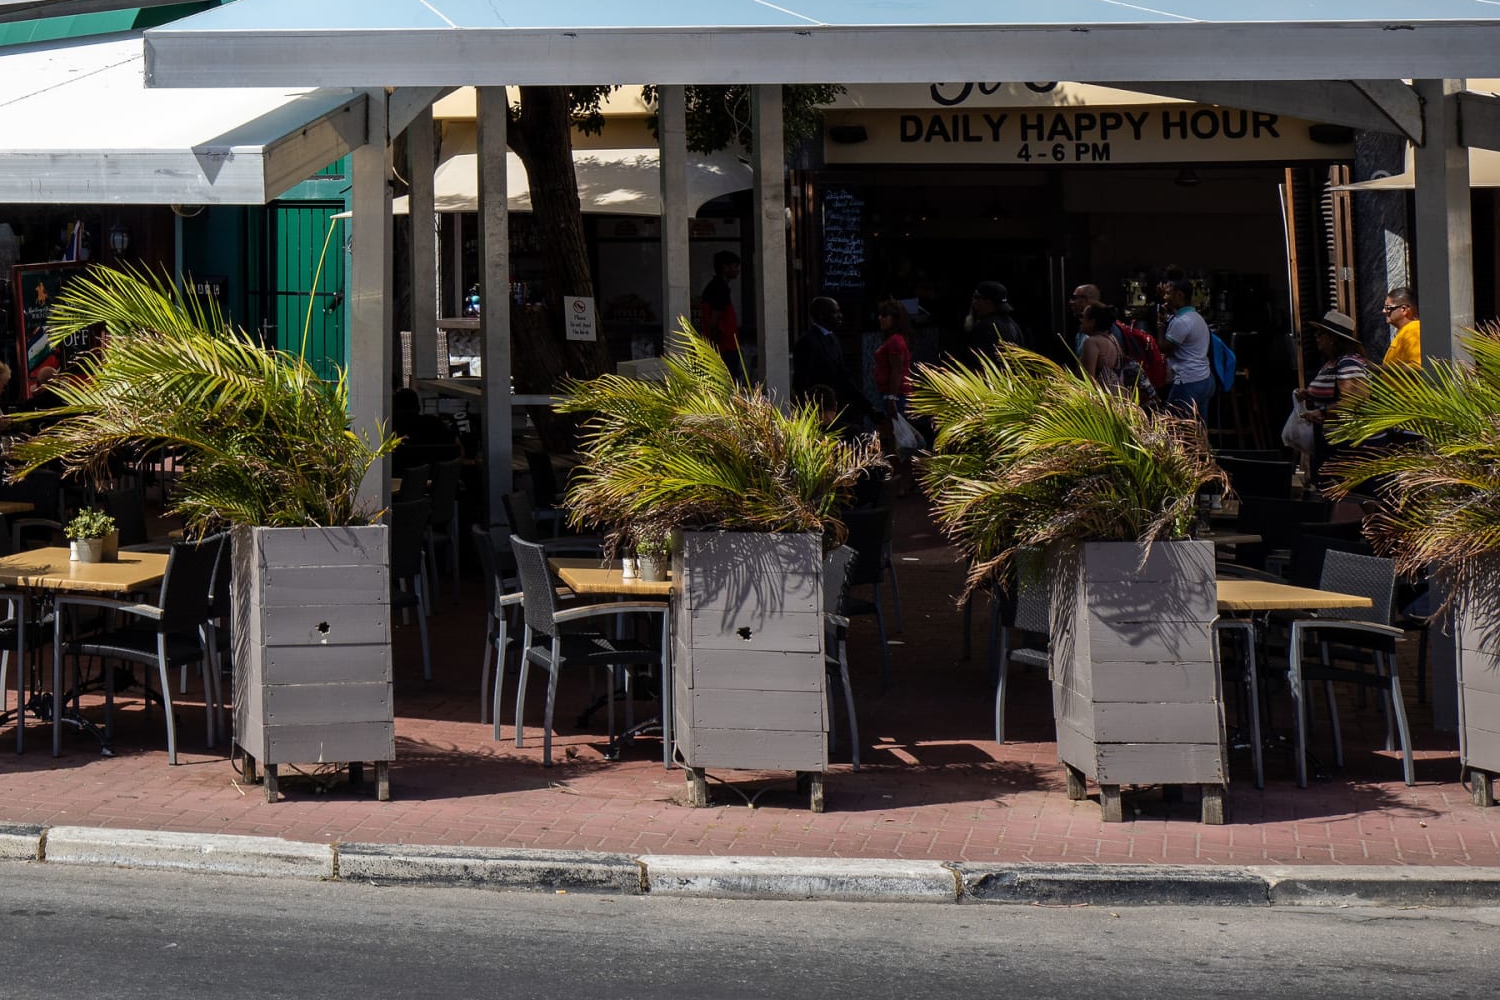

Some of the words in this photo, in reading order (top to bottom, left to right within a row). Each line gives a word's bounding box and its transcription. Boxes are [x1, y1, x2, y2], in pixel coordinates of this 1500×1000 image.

[900, 112, 1008, 143] DAILY
[1020, 110, 1150, 142] HAPPY
[1163, 109, 1281, 140] HOUR
[1018, 144, 1031, 162] 4
[1052, 144, 1065, 161] 6
[1076, 143, 1111, 161] PM
[63, 329, 90, 347] OFF
